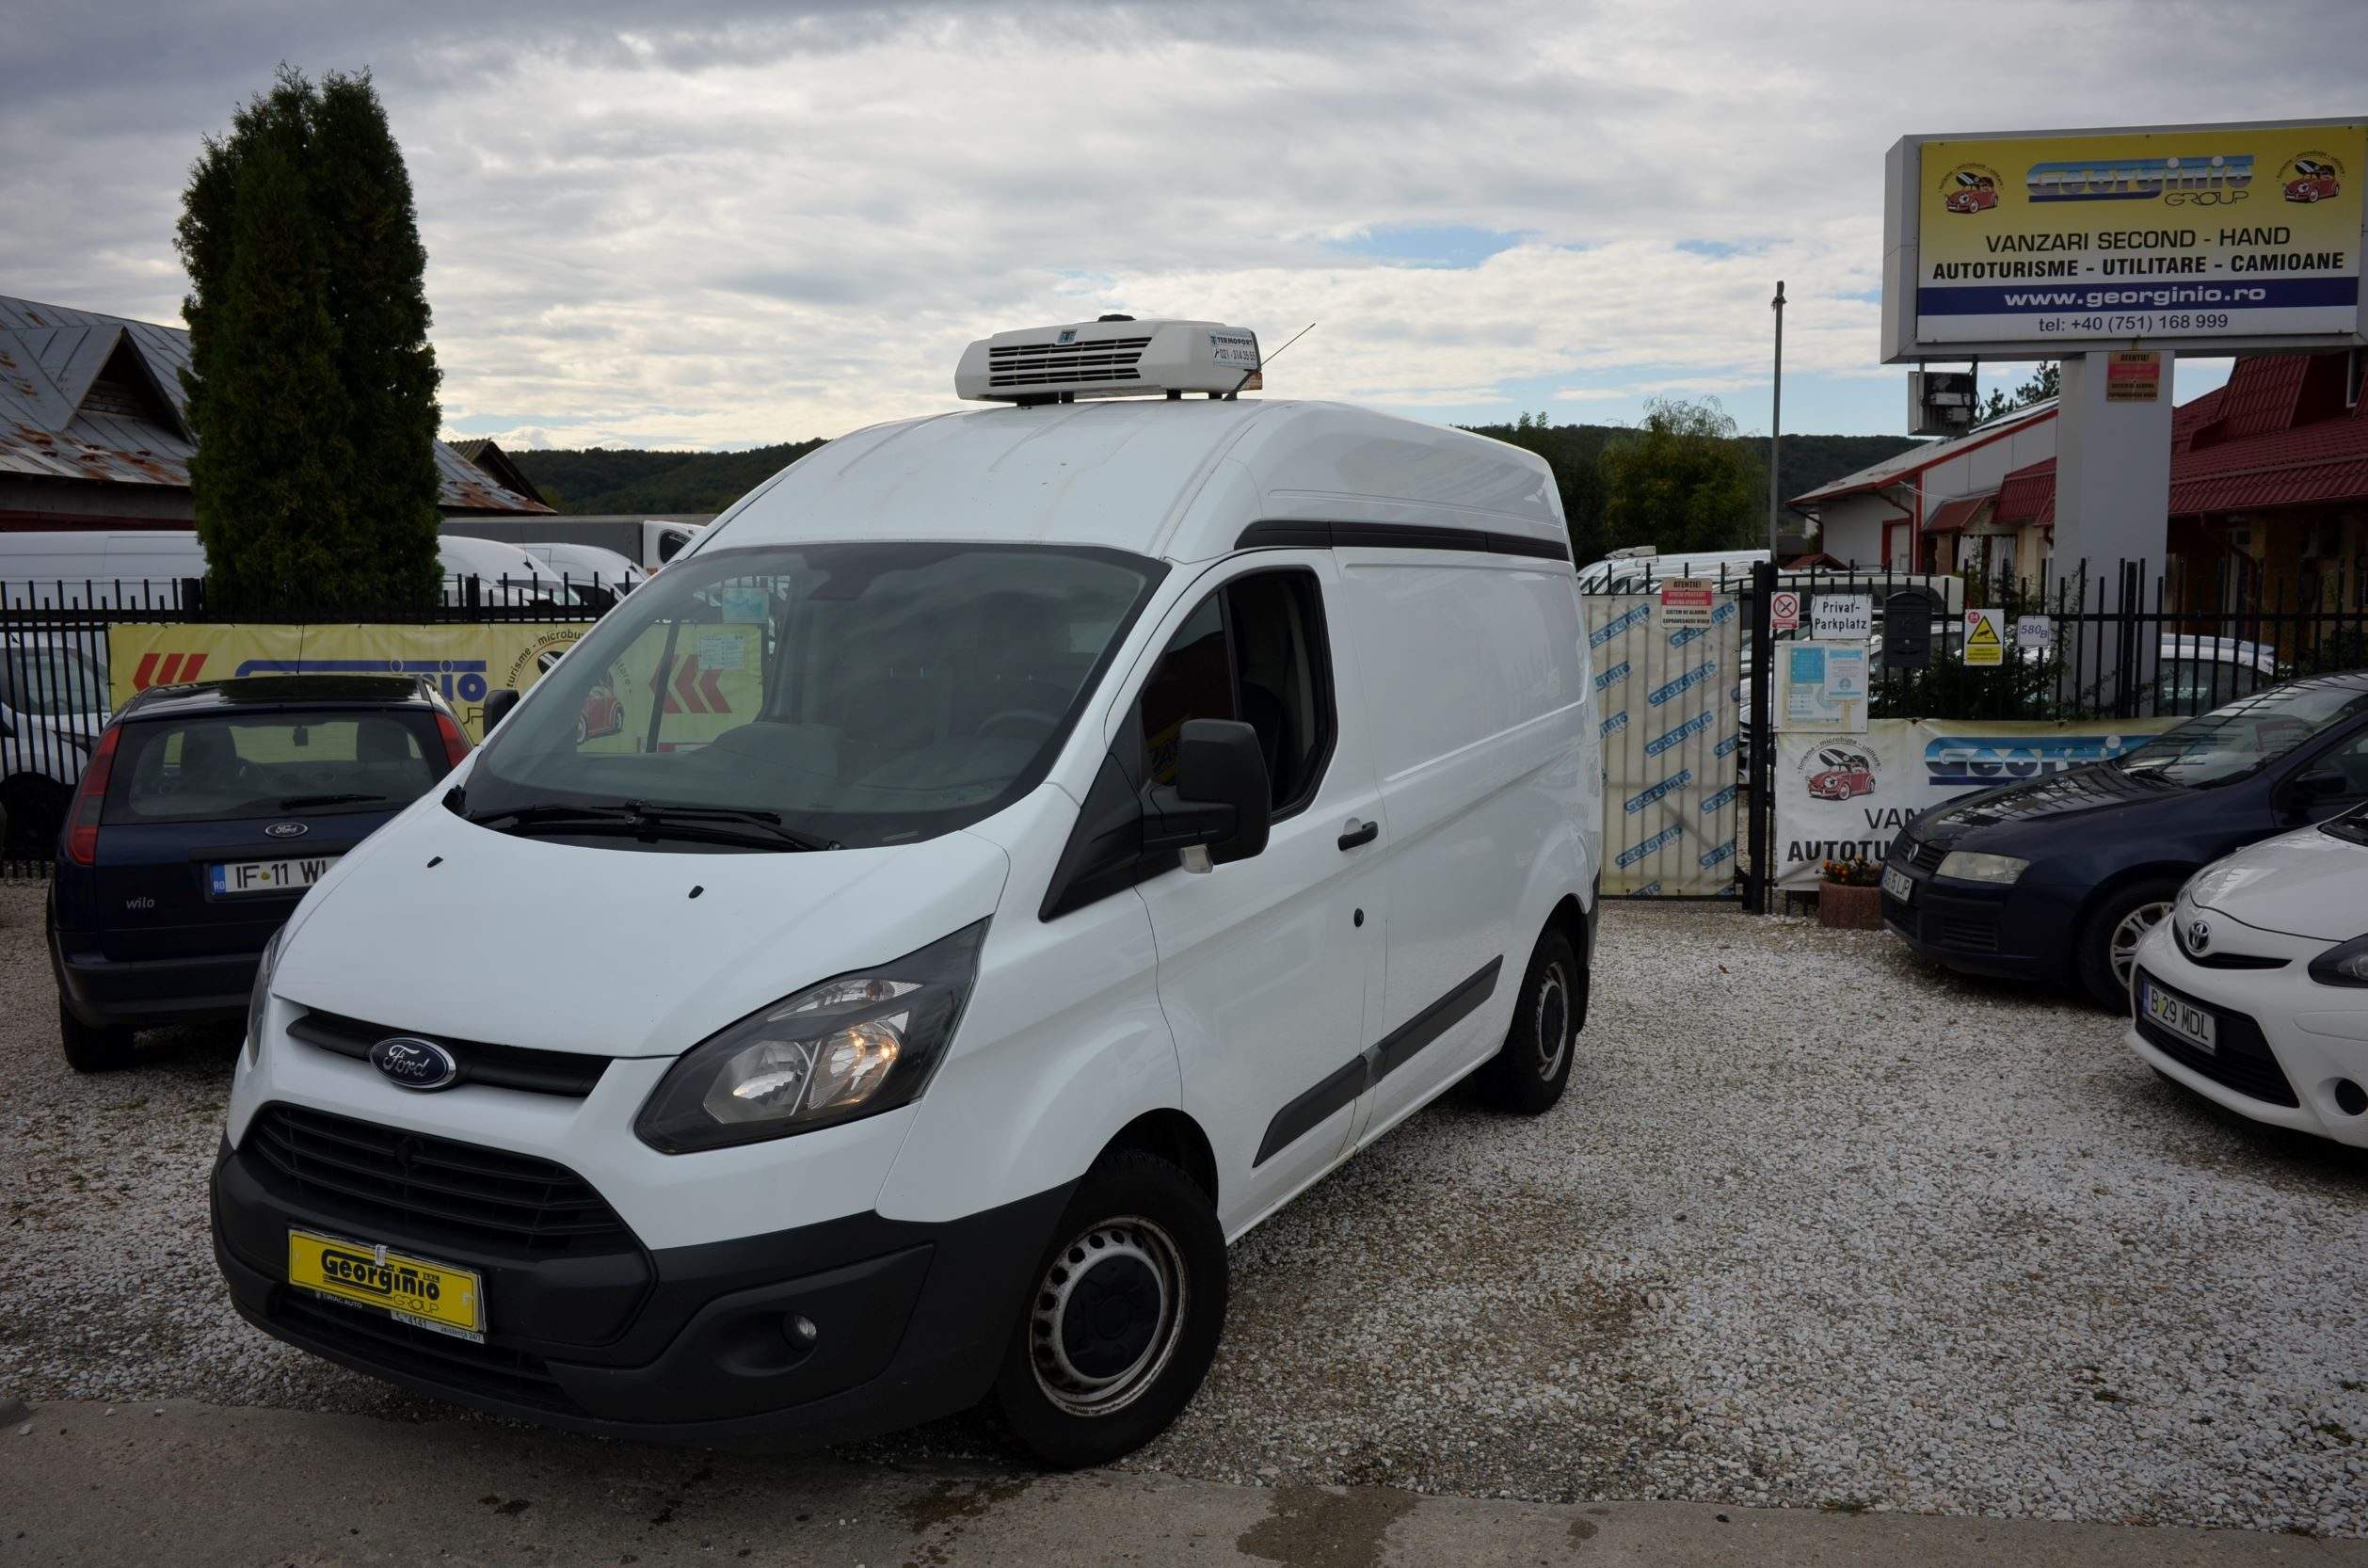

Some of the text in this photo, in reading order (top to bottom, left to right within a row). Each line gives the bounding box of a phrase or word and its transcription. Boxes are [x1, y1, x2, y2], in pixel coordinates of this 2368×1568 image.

[2027, 155, 2254, 203] Georginio
[2165, 191, 2249, 206] GROUP
[1986, 233, 2088, 253] VANZARI
[2098, 231, 2196, 250] SECOND
[2219, 227, 2291, 247] HAND
[1932, 260, 2079, 280] AUTOTURISME
[2103, 256, 2207, 276] UTILITARE
[2231, 252, 2344, 272] CAMIOANE
[2005, 286, 2266, 308] www.georginio.ro
[2039, 313, 2229, 333] tel: +40 (751) 168 999
[1823, 601, 1861, 614] Privat-
[1815, 618, 1867, 632] Parkplatz
[538, 629, 585, 646] microbu
[506, 647, 541, 688] turisme
[1787, 840, 1890, 862] AUTOTU
[213, 881, 226, 890] RO
[236, 864, 261, 888] IF
[272, 863, 290, 886] 11
[2151, 988, 2159, 1014] B
[2181, 1004, 2209, 1041] MDL
[383, 1045, 430, 1077] Ford
[321, 1248, 441, 1303] Georginio
[392, 1294, 440, 1315] GROUP
